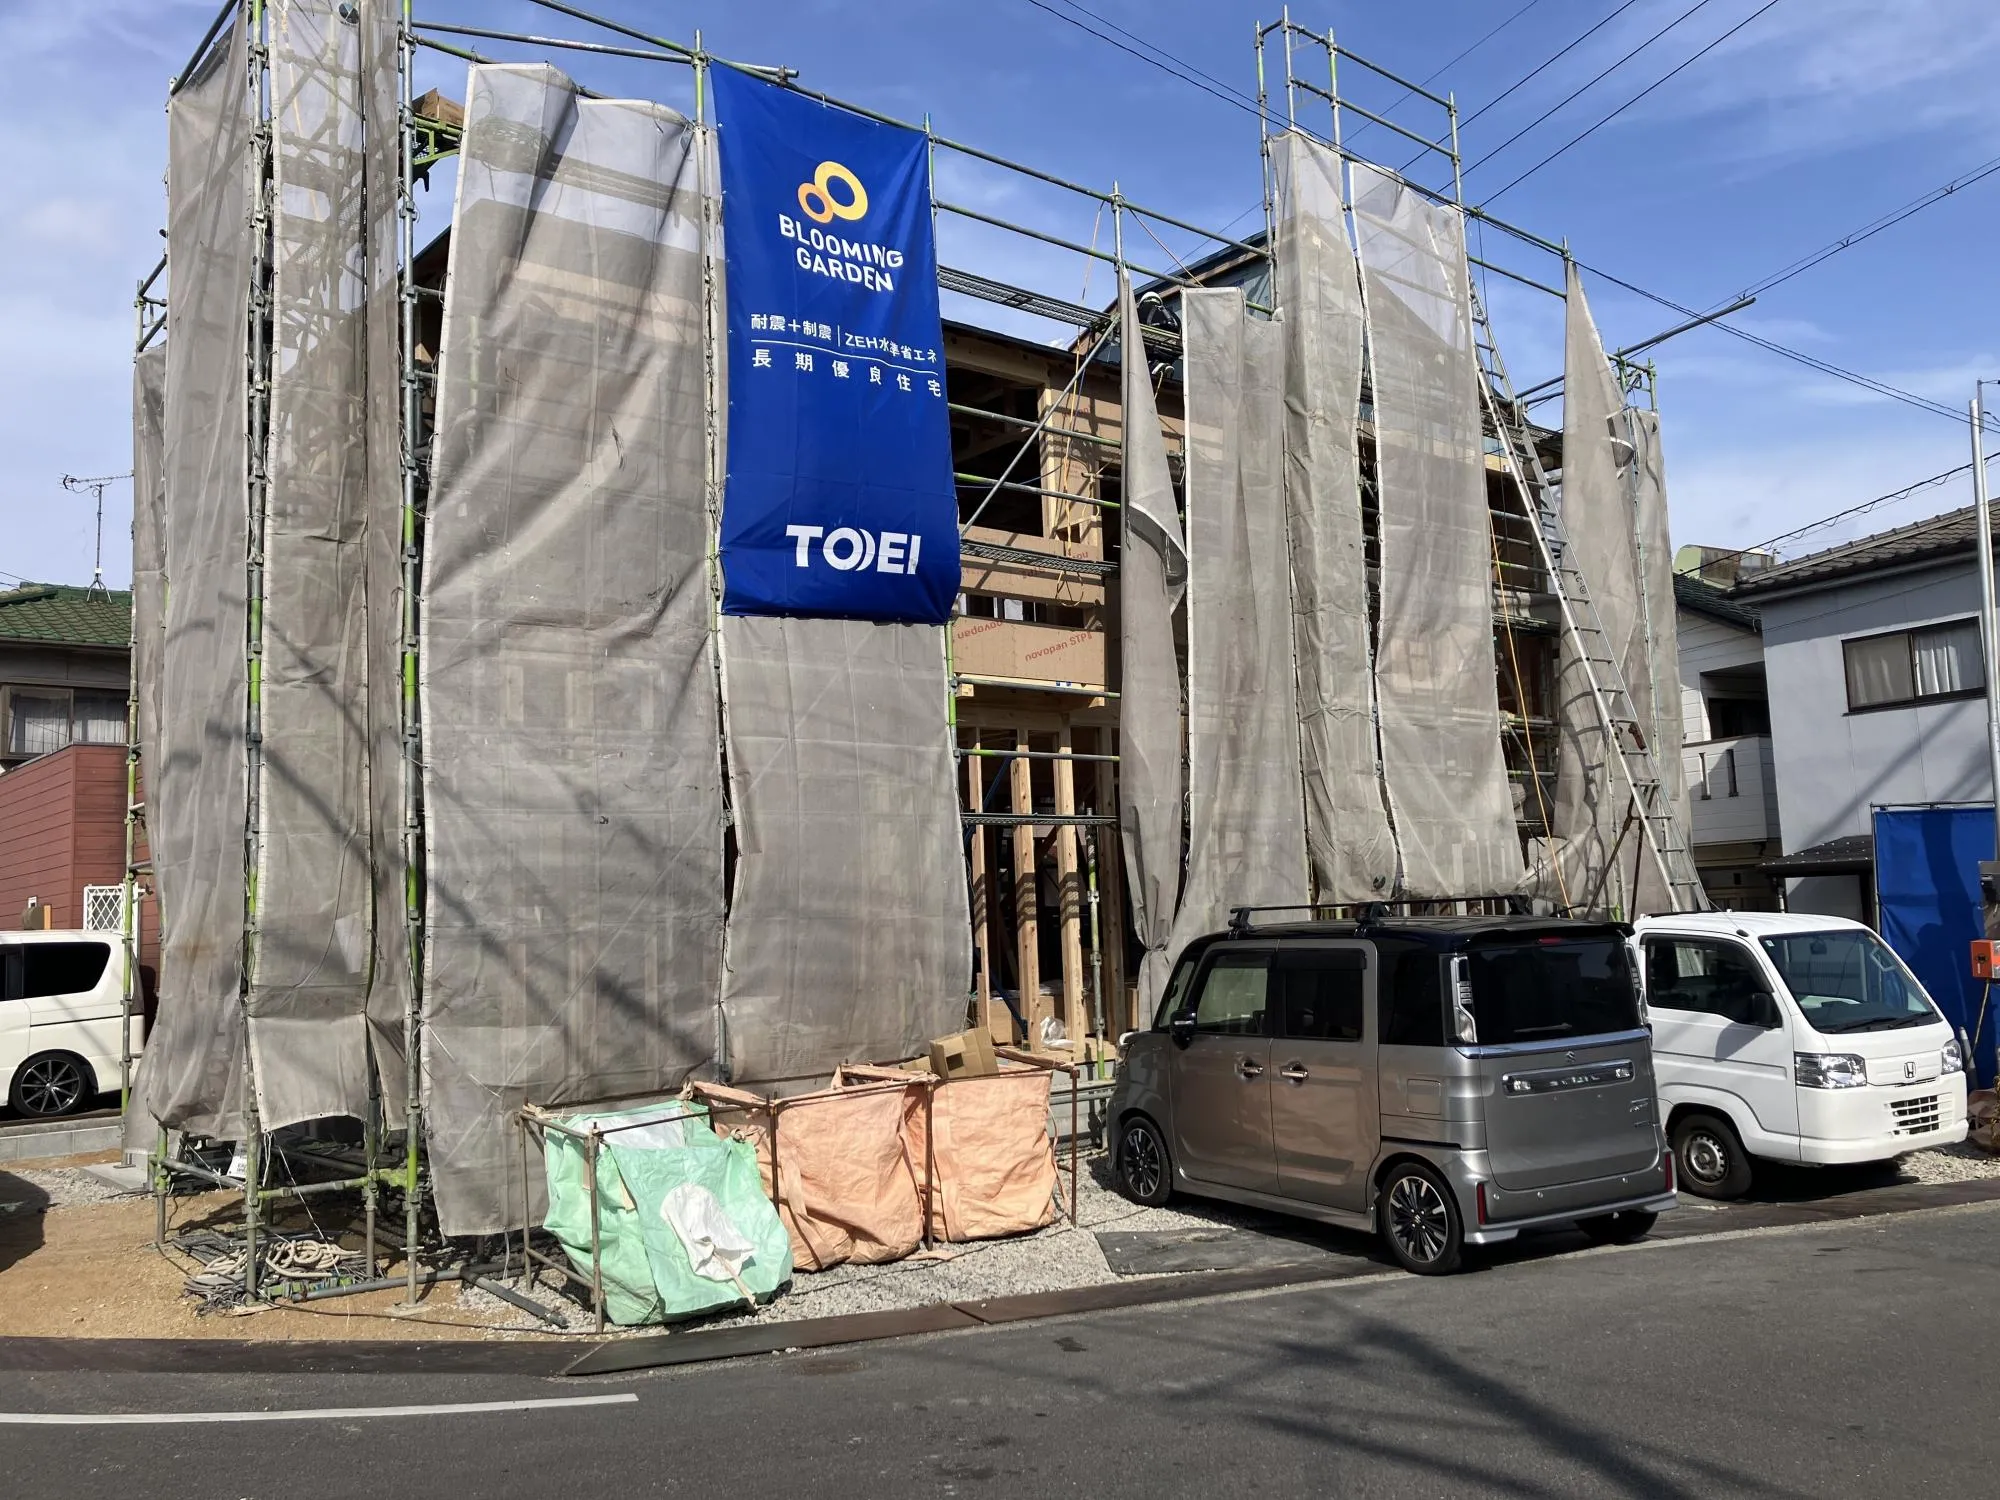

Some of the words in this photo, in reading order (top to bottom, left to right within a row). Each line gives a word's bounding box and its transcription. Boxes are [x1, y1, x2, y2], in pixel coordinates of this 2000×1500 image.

[778, 213, 904, 268] BLOOMING
[796, 247, 894, 292] GARDEN
[844, 332, 937, 364] ZEH水準省エネ
[752, 349, 942, 398] 長期優良住宅
[785, 524, 922, 575] TOEI
[1024, 640, 1068, 662] novopan
